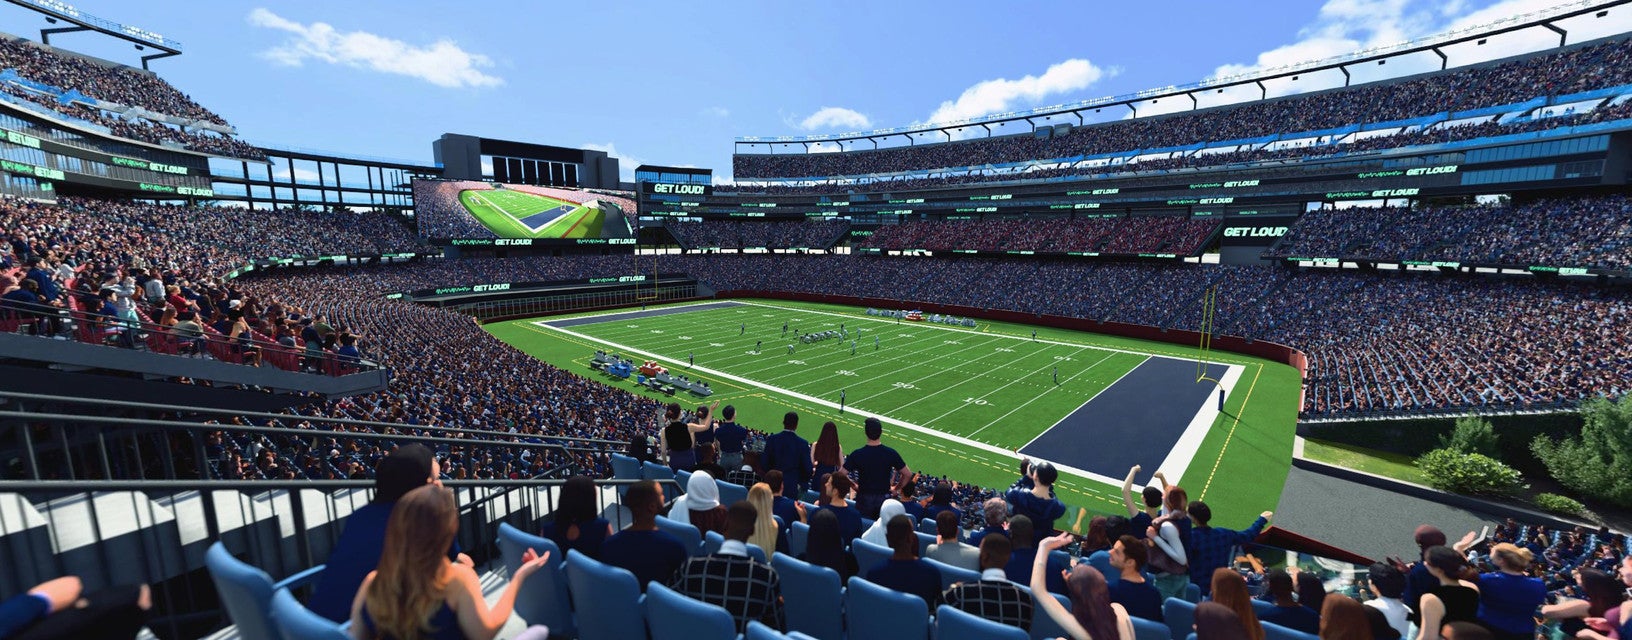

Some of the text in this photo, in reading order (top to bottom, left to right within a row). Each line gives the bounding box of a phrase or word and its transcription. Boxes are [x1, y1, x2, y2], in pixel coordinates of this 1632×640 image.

[1426, 166, 1458, 174] LOUD!
[654, 184, 705, 194] GET LOUD!
[1223, 226, 1289, 237] GET LOUD
